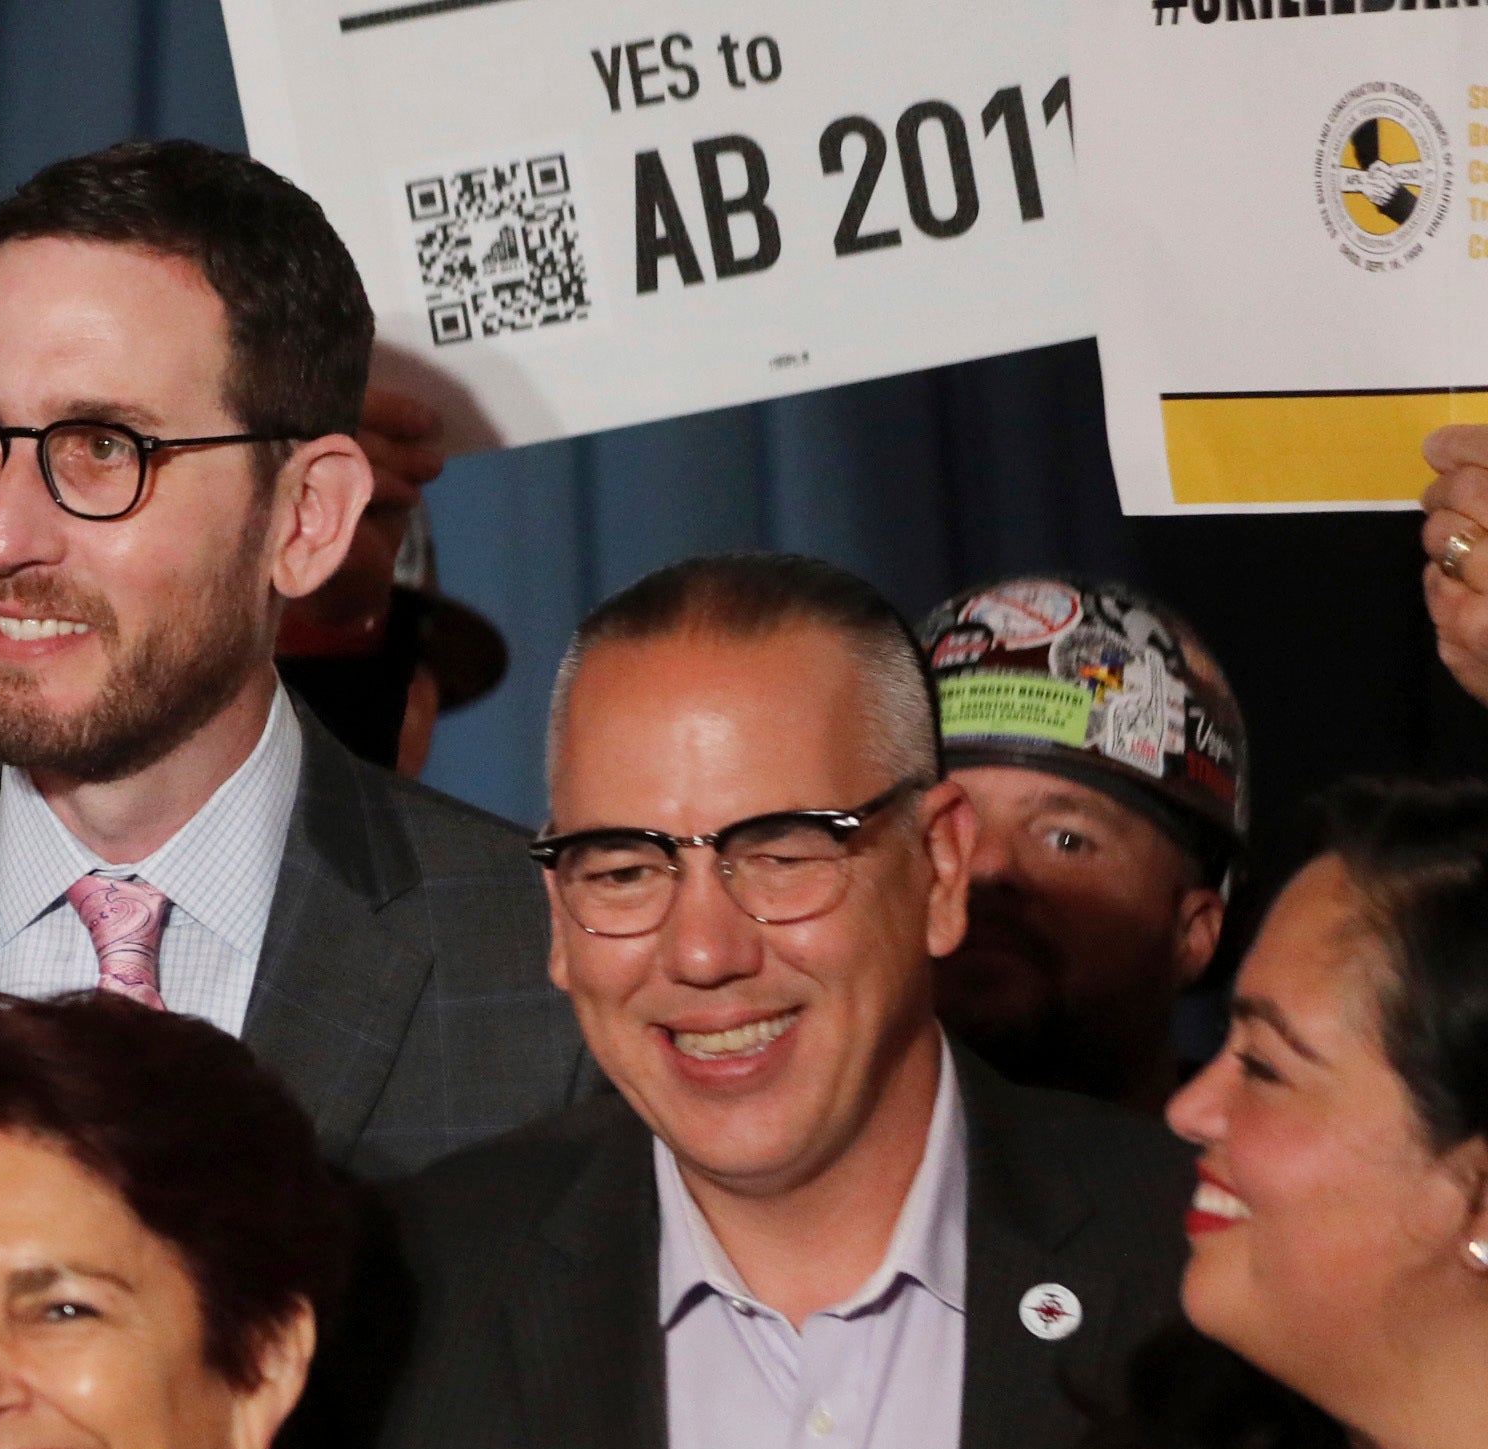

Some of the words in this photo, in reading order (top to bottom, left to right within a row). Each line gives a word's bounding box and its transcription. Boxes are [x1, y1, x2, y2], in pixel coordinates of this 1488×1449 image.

[591, 33, 700, 112] YES
[717, 34, 783, 89] to
[634, 134, 782, 295] AB
